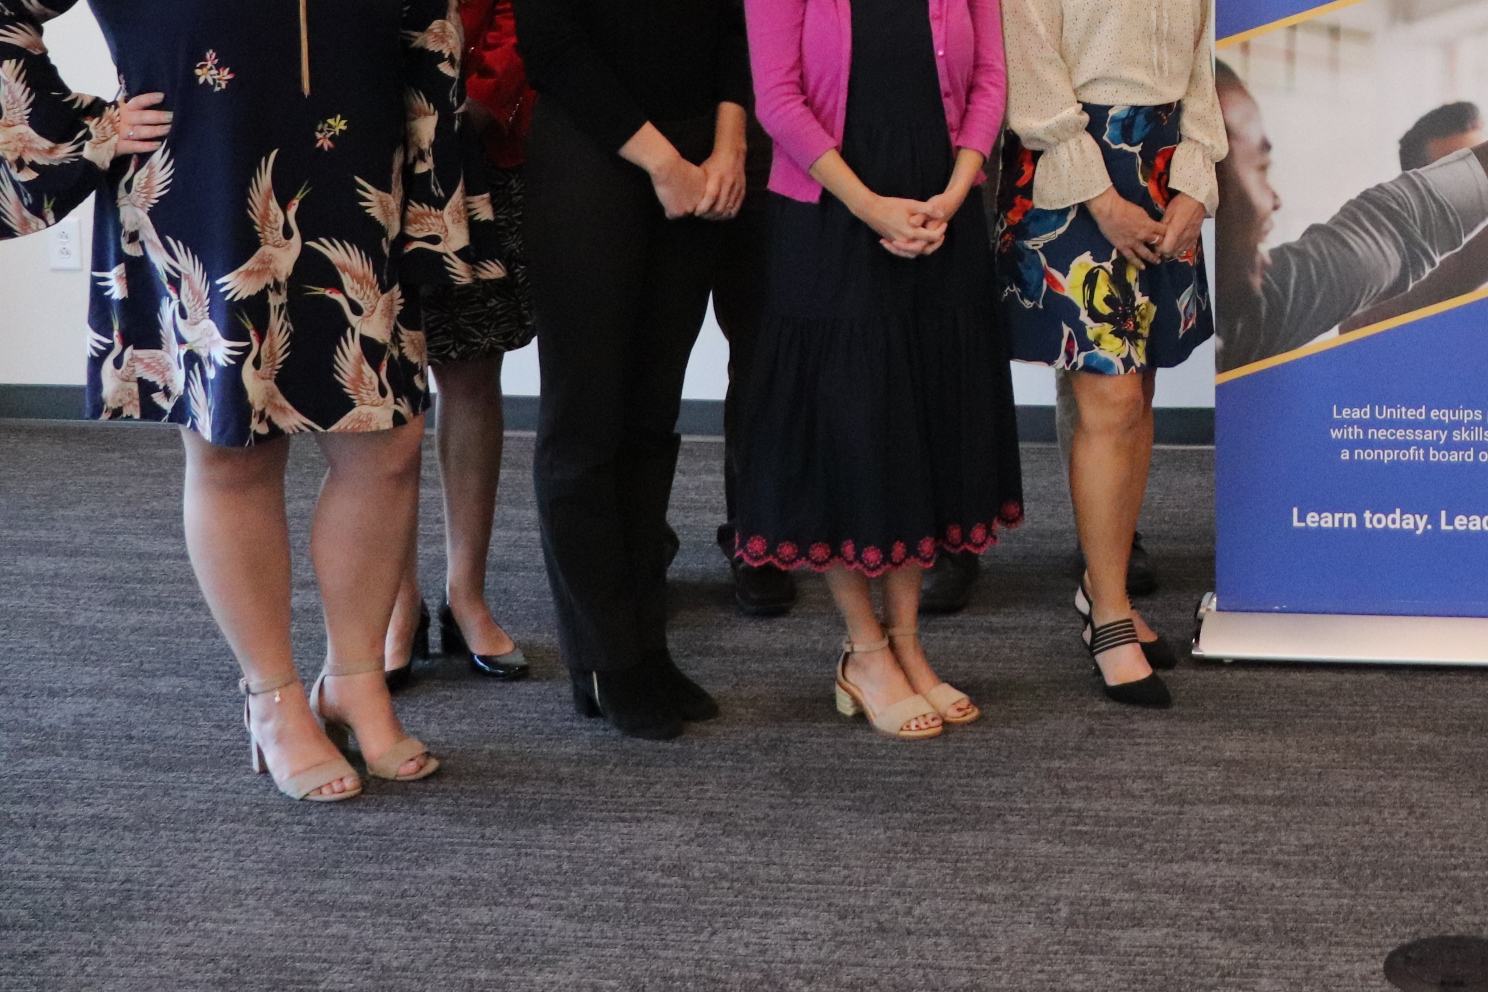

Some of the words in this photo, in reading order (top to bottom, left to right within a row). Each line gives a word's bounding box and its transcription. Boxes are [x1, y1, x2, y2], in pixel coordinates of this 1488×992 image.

[1333, 404, 1370, 419] Lead
[1375, 405, 1425, 420] United
[1430, 406, 1482, 424] equips
[1330, 425, 1363, 439] with
[1368, 430, 1447, 444] necessary
[1341, 449, 1349, 460] a
[1355, 446, 1424, 463] nonprofit
[1430, 447, 1473, 462] board
[1293, 507, 1356, 528] Learn
[1363, 508, 1432, 535] today.
